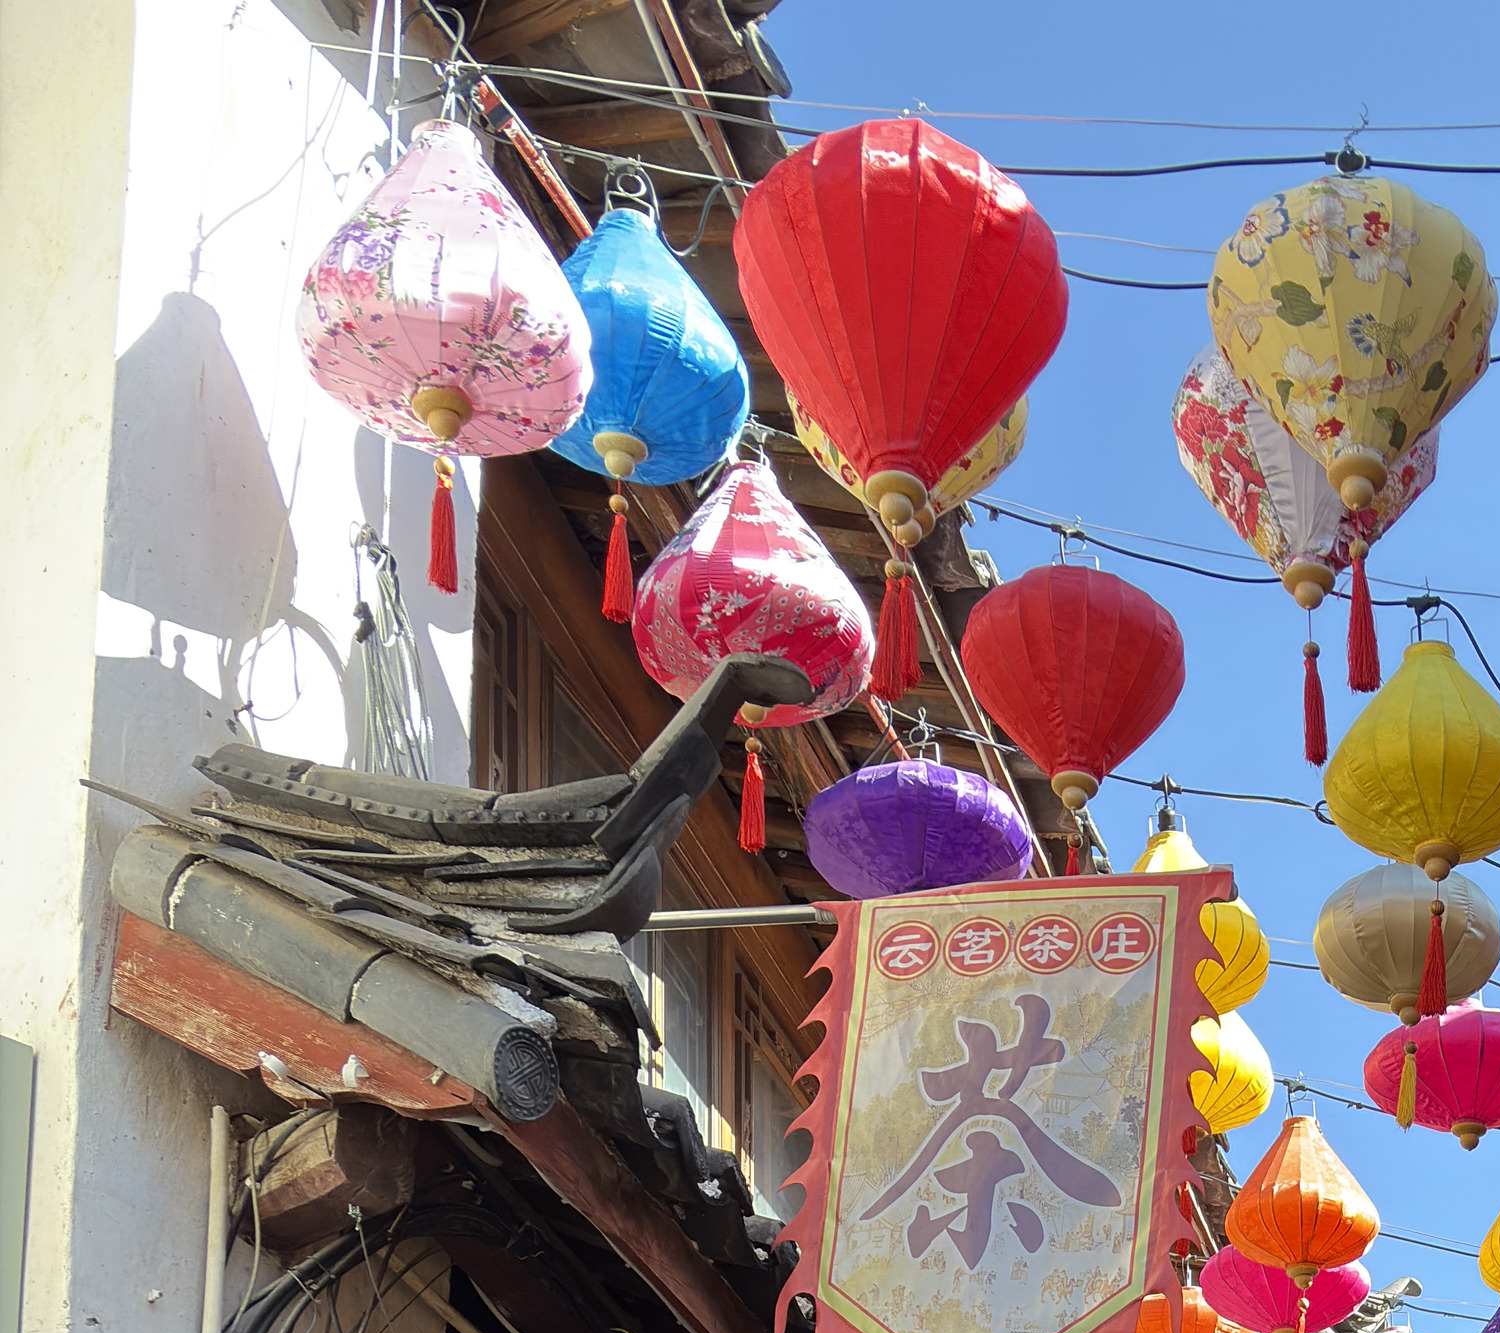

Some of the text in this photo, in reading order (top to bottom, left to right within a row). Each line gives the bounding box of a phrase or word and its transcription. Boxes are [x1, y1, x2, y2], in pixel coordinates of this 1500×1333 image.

[880, 921, 1146, 971] 云茗茶庄
[859, 993, 1123, 1270] 茶
